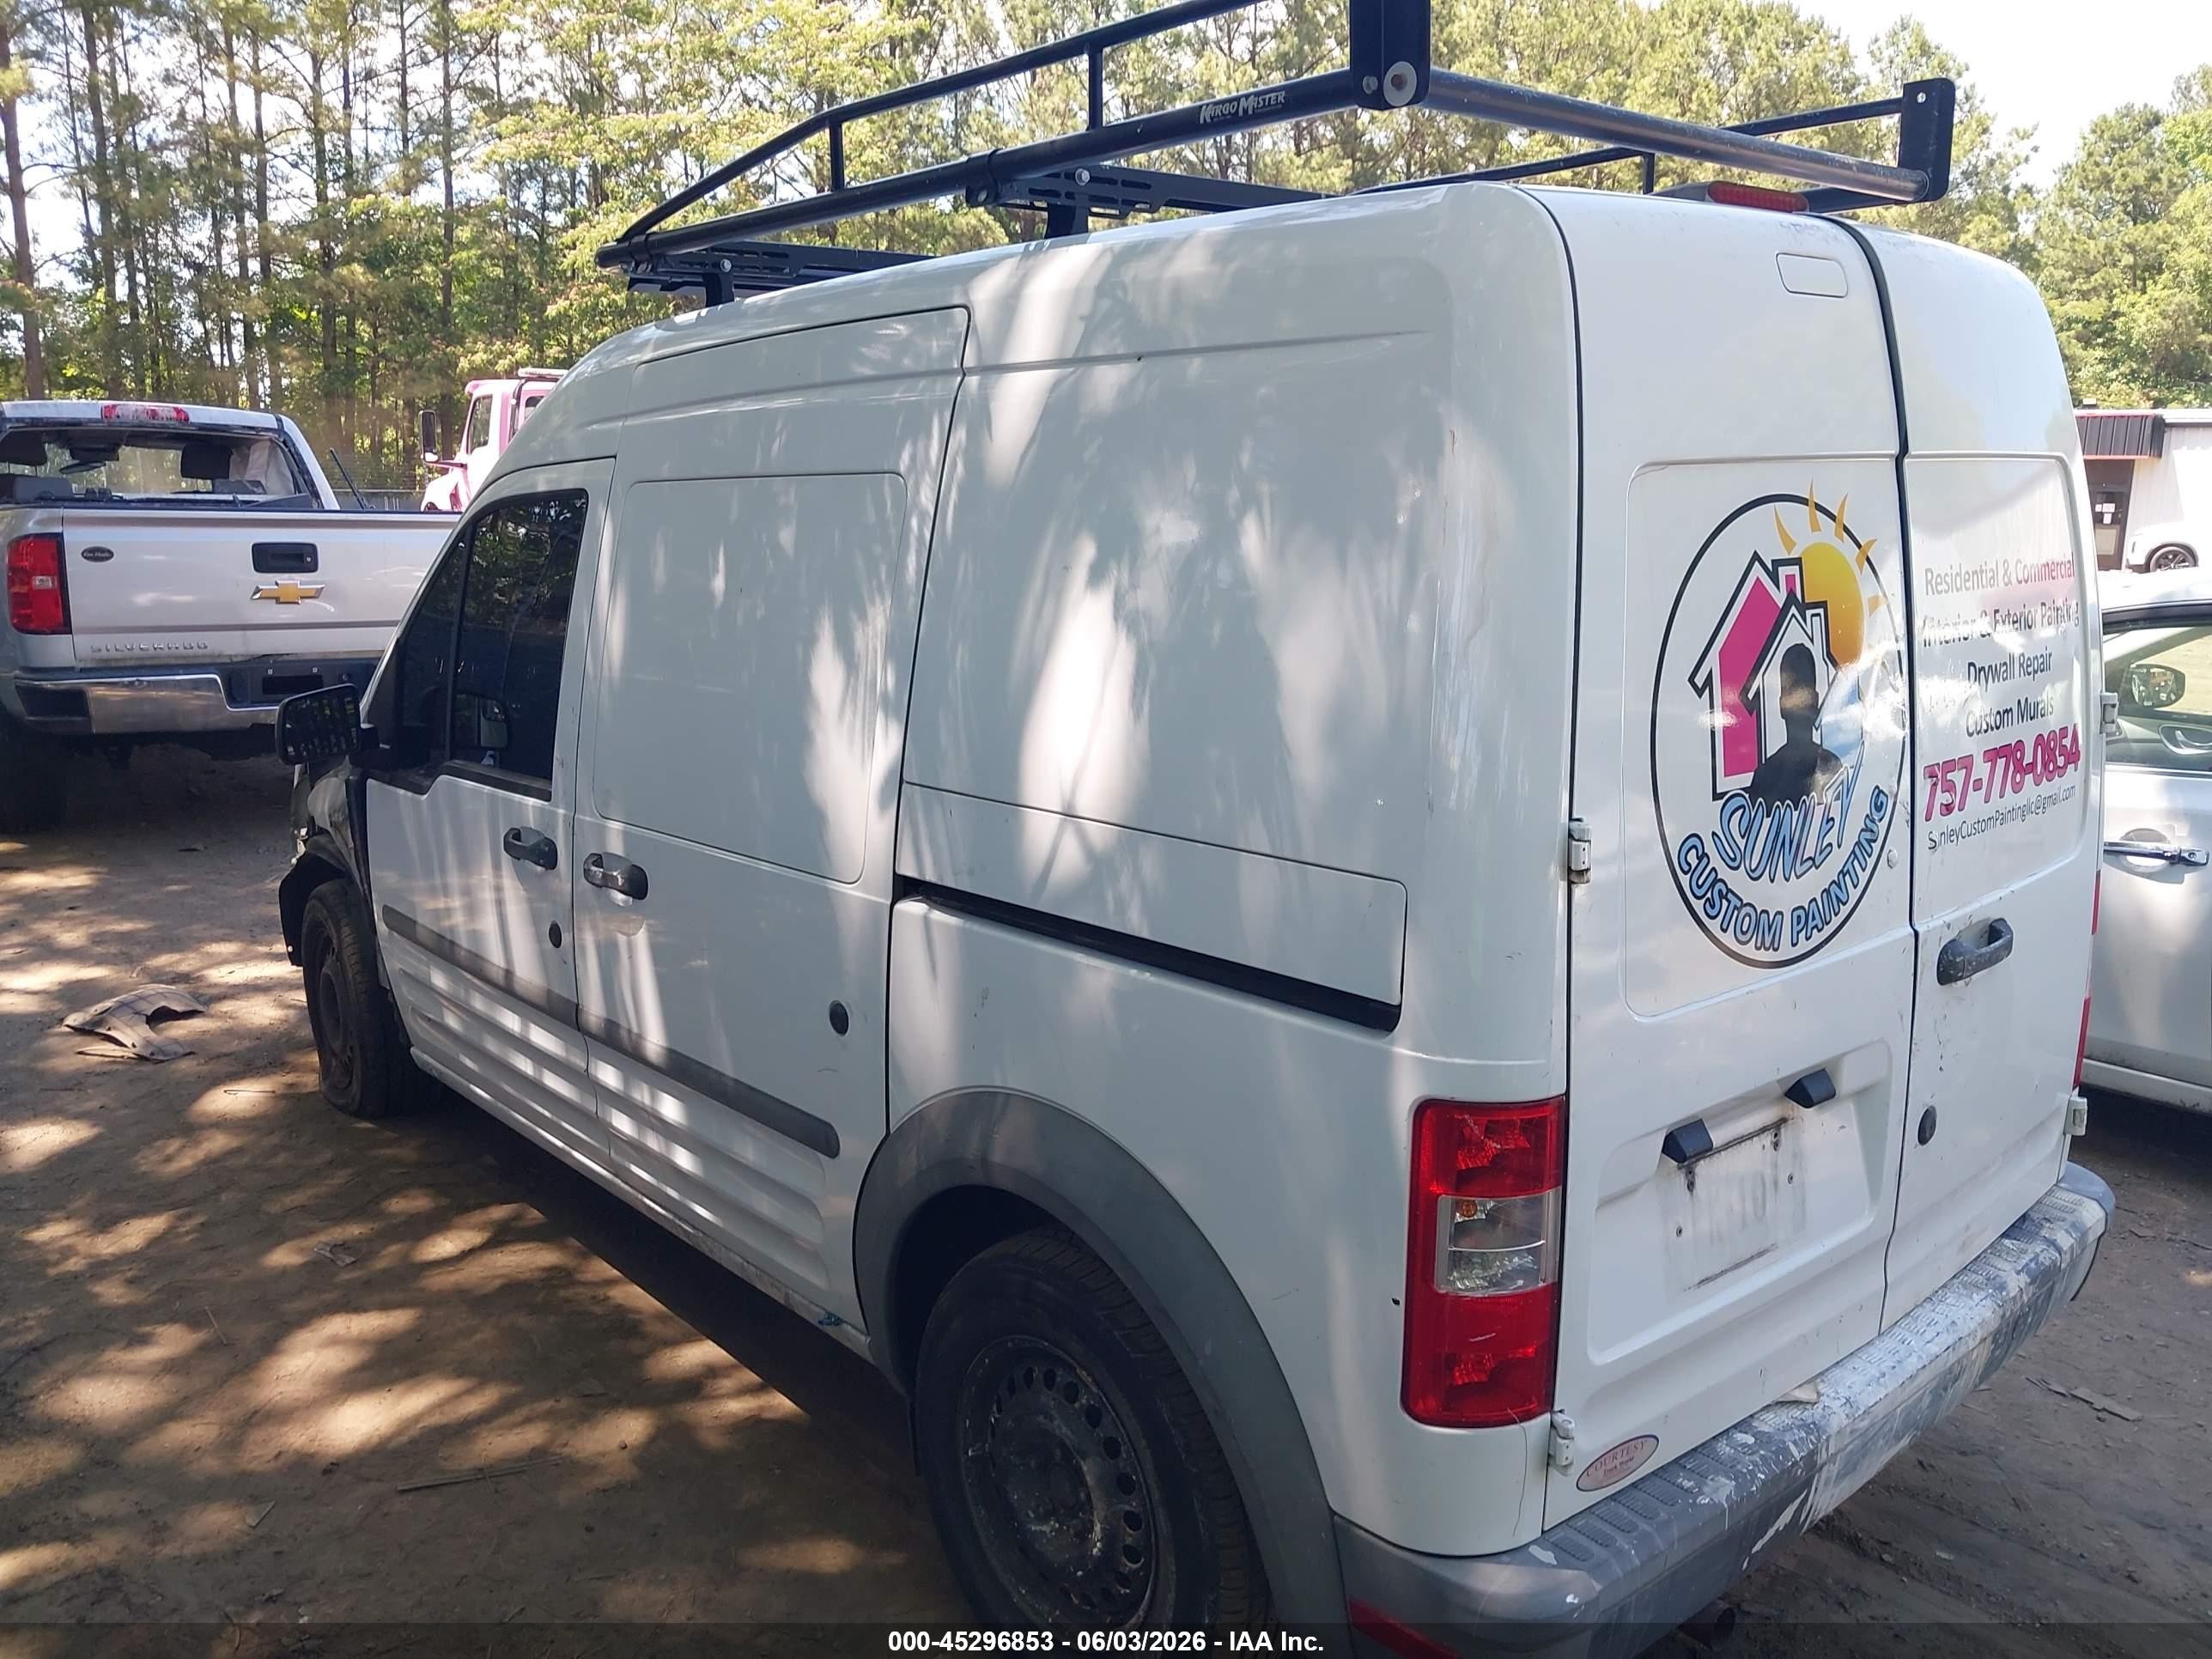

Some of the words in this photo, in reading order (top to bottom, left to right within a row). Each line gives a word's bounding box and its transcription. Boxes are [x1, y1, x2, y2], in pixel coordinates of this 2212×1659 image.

[1924, 560, 2000, 596] Residential
[2002, 558, 2013, 587] &
[2015, 551, 2075, 585] Commercial
[1993, 603, 2039, 633] Exterior
[1967, 652, 2015, 693] Drywall
[2018, 645, 2053, 682] Repair
[1966, 707, 2014, 738] Custom
[2016, 687, 2054, 725] Murals
[1923, 722, 2081, 822] 757-778-0854
[1711, 740, 1865, 884] SUNLEY
[1928, 785, 2076, 851] SnleyCustomPaintingllc@gmail.com
[1677, 832, 1784, 952] CUSTOM
[1790, 785, 1889, 947] PAINTING
